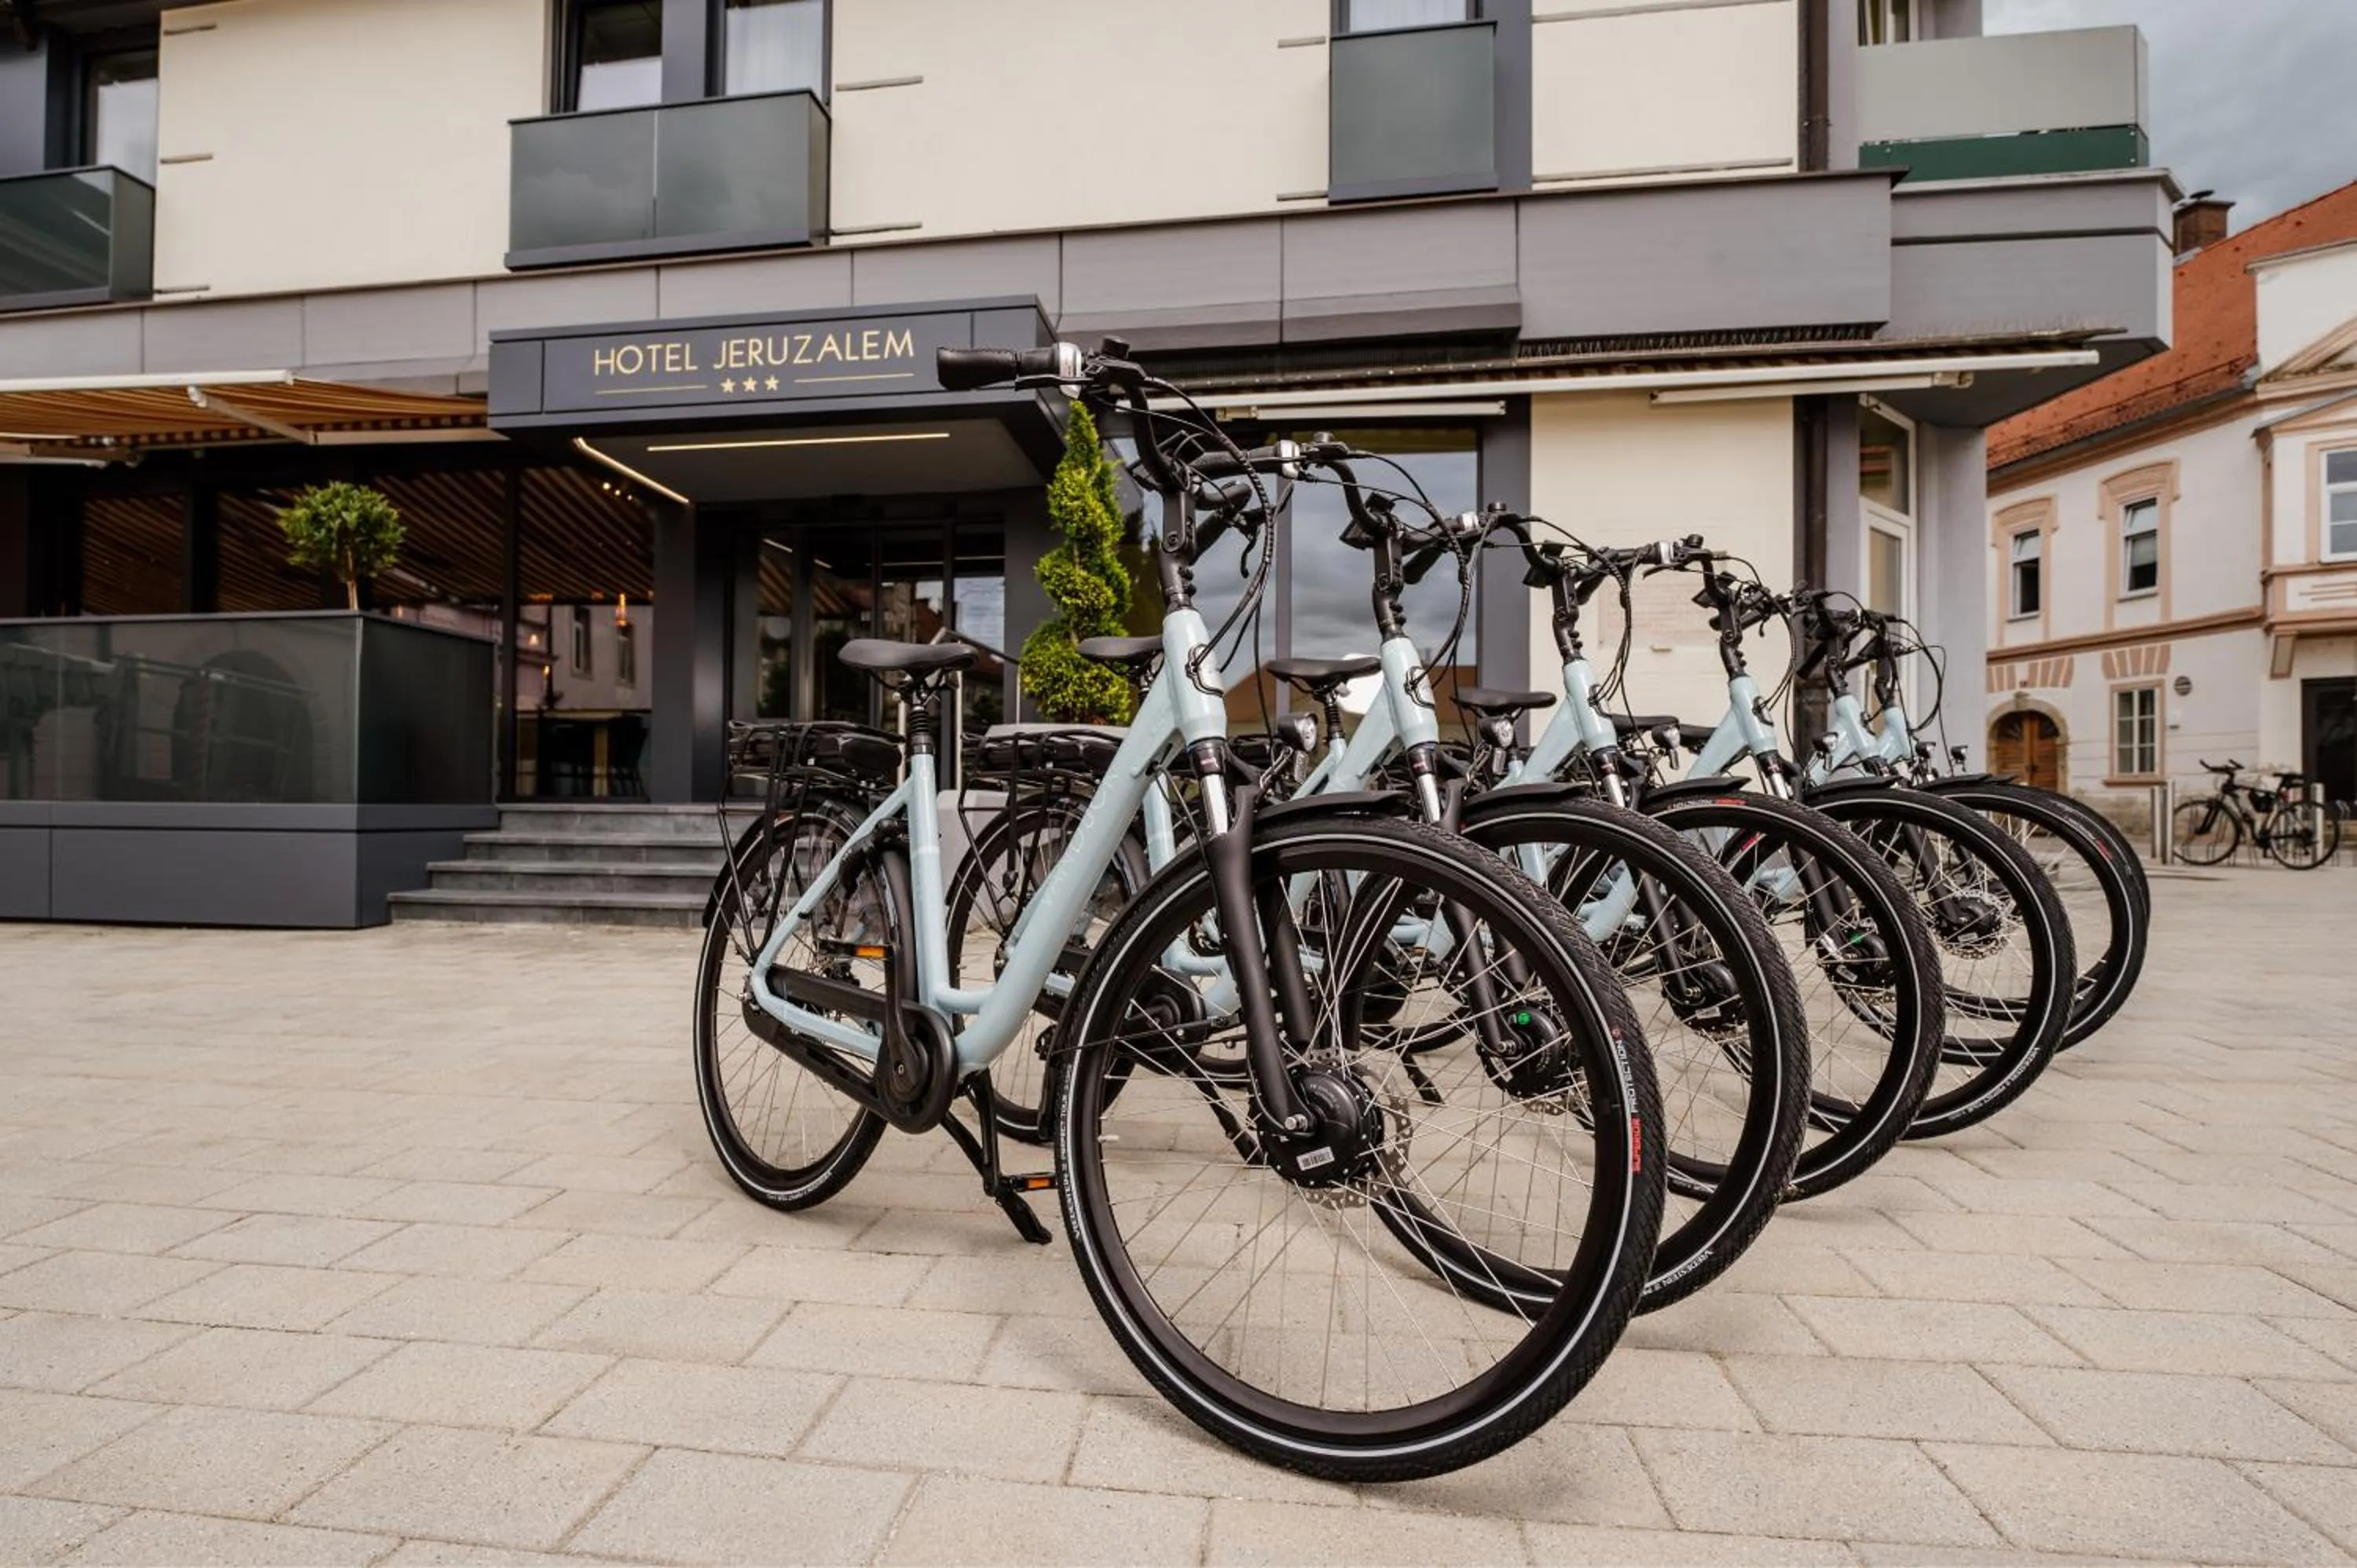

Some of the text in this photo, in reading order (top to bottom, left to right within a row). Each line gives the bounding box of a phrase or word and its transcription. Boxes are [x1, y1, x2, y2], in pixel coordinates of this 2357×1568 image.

[595, 328, 915, 376] HOTEL JERUZALEM
[1615, 1039, 1639, 1113] PROTECTION
